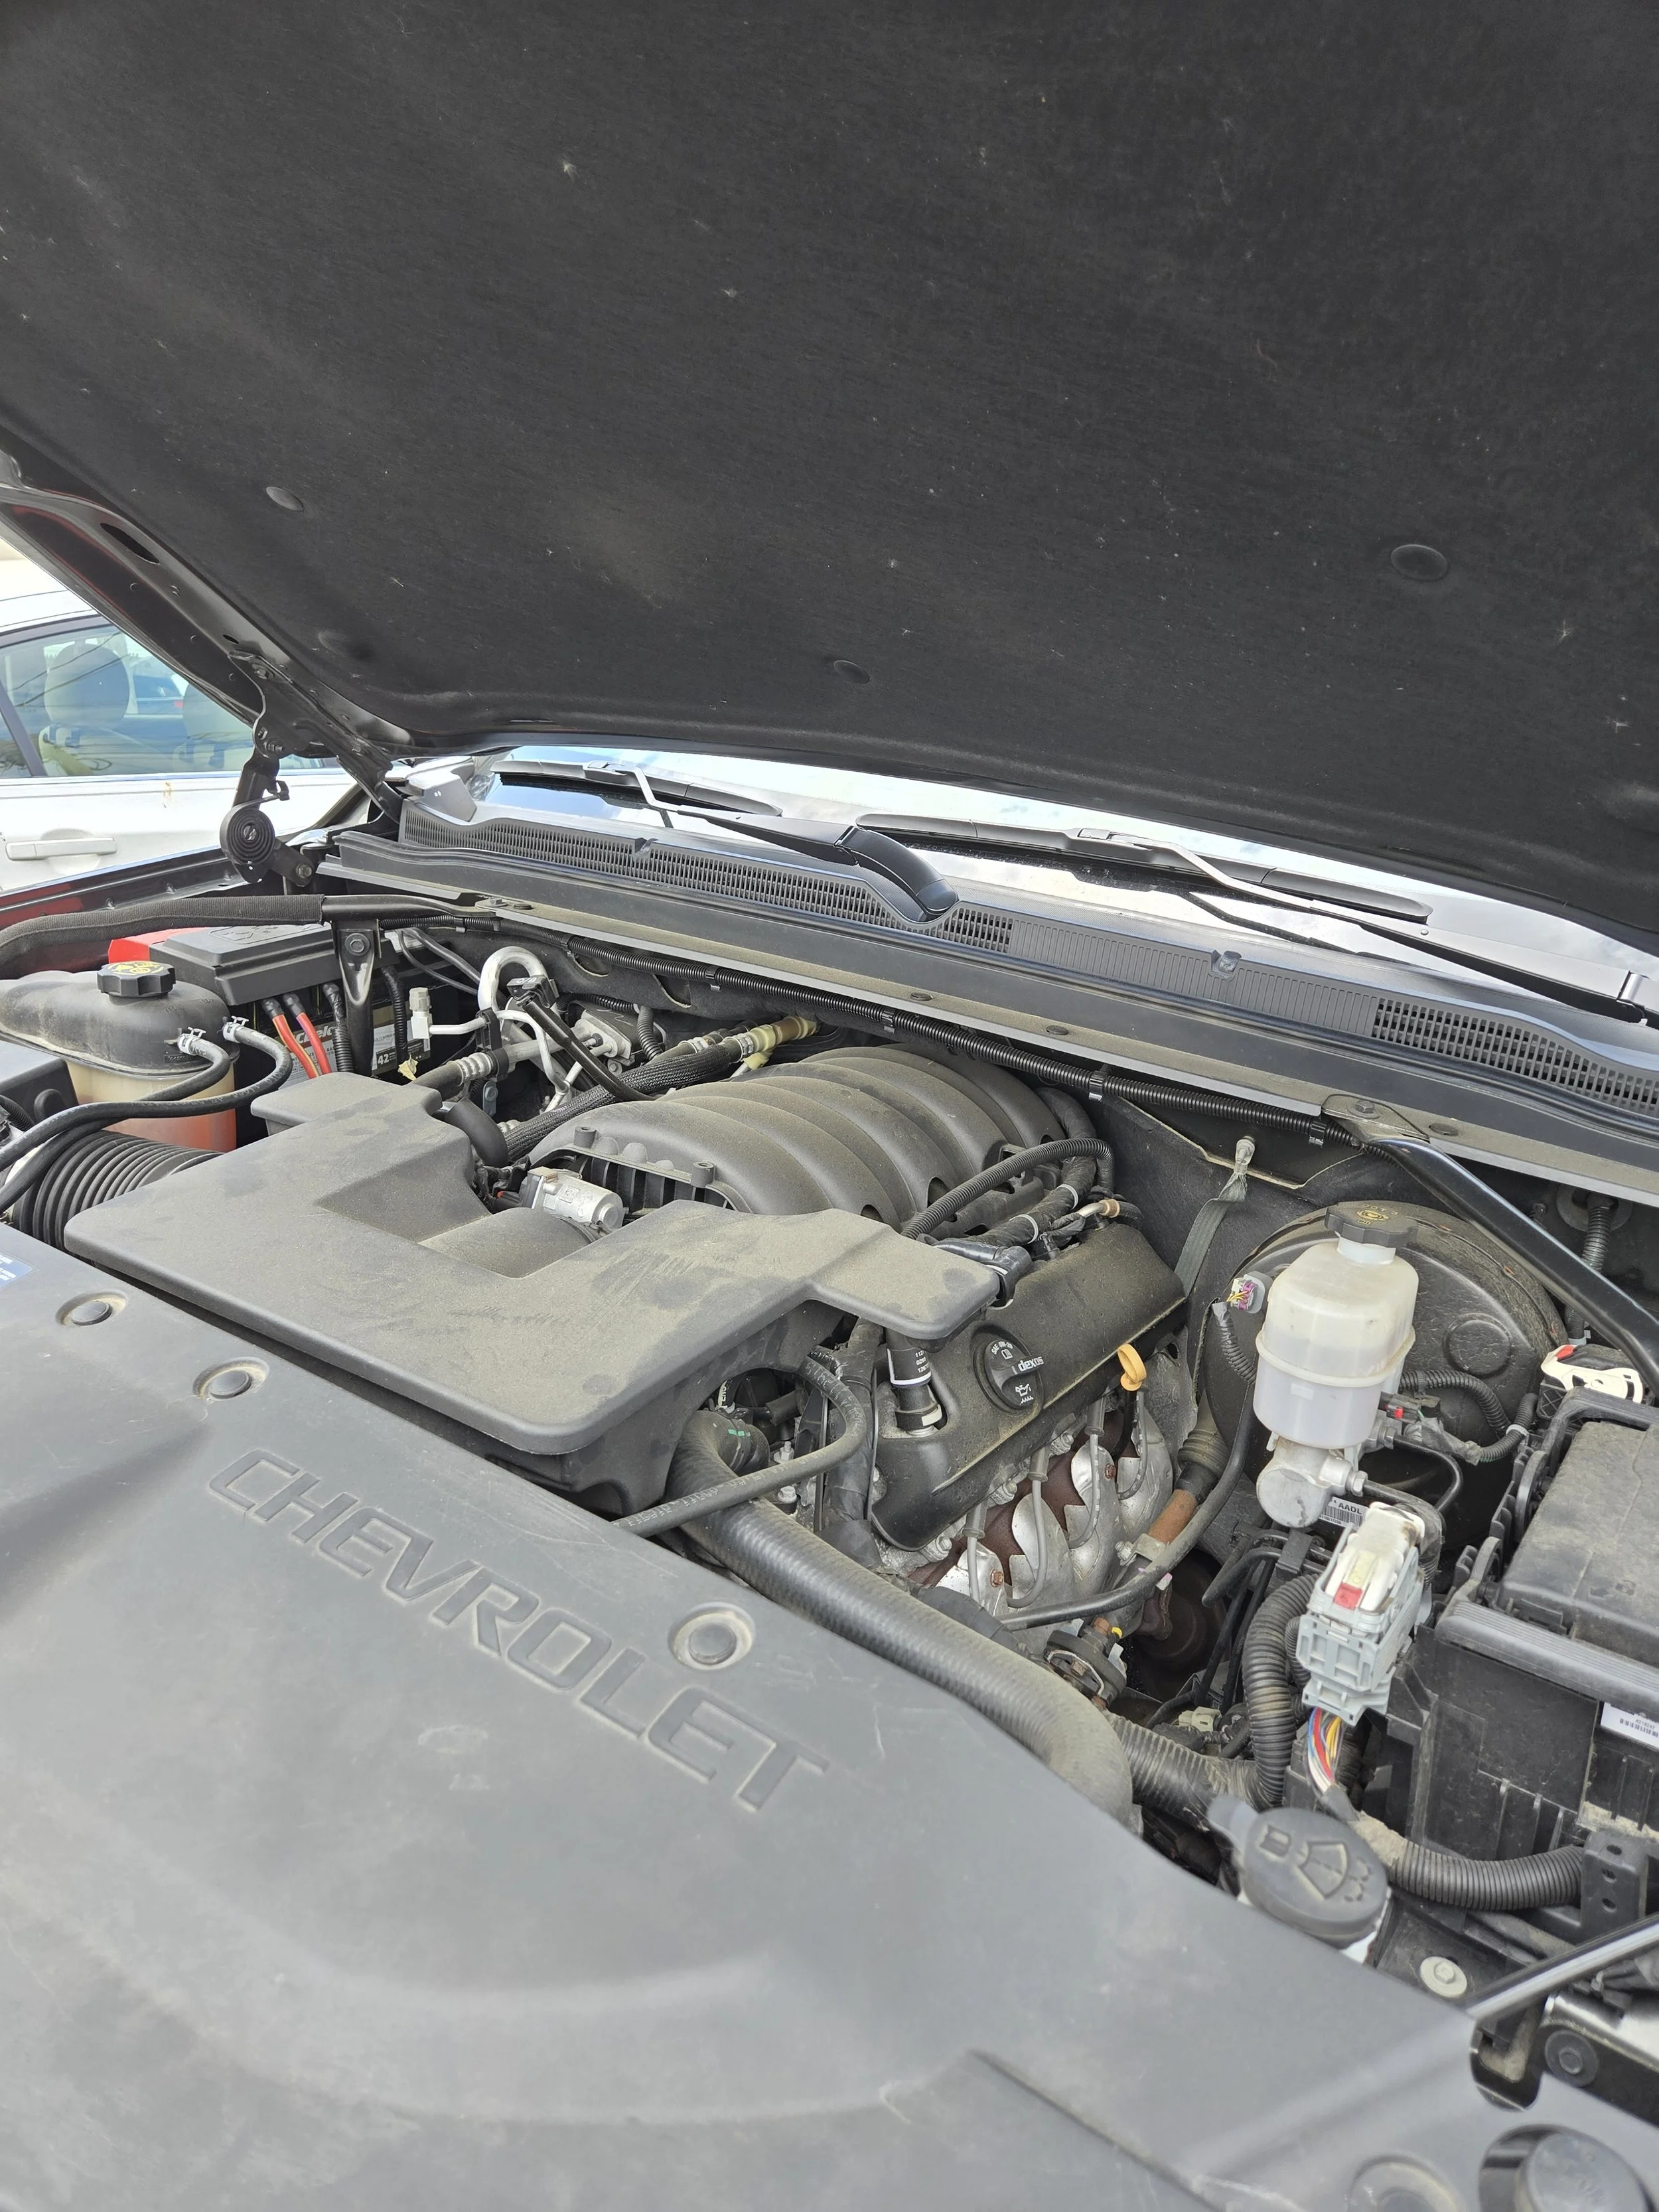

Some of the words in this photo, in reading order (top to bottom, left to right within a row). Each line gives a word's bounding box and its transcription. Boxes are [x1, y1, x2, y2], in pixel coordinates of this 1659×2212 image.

[377, 1053, 390, 1065] 42
[991, 1343, 1000, 1355] SAE
[1017, 1356, 1045, 1372] dexos
[1338, 1503, 1362, 1514] AADL
[209, 1447, 830, 1813] CHEVROLET
